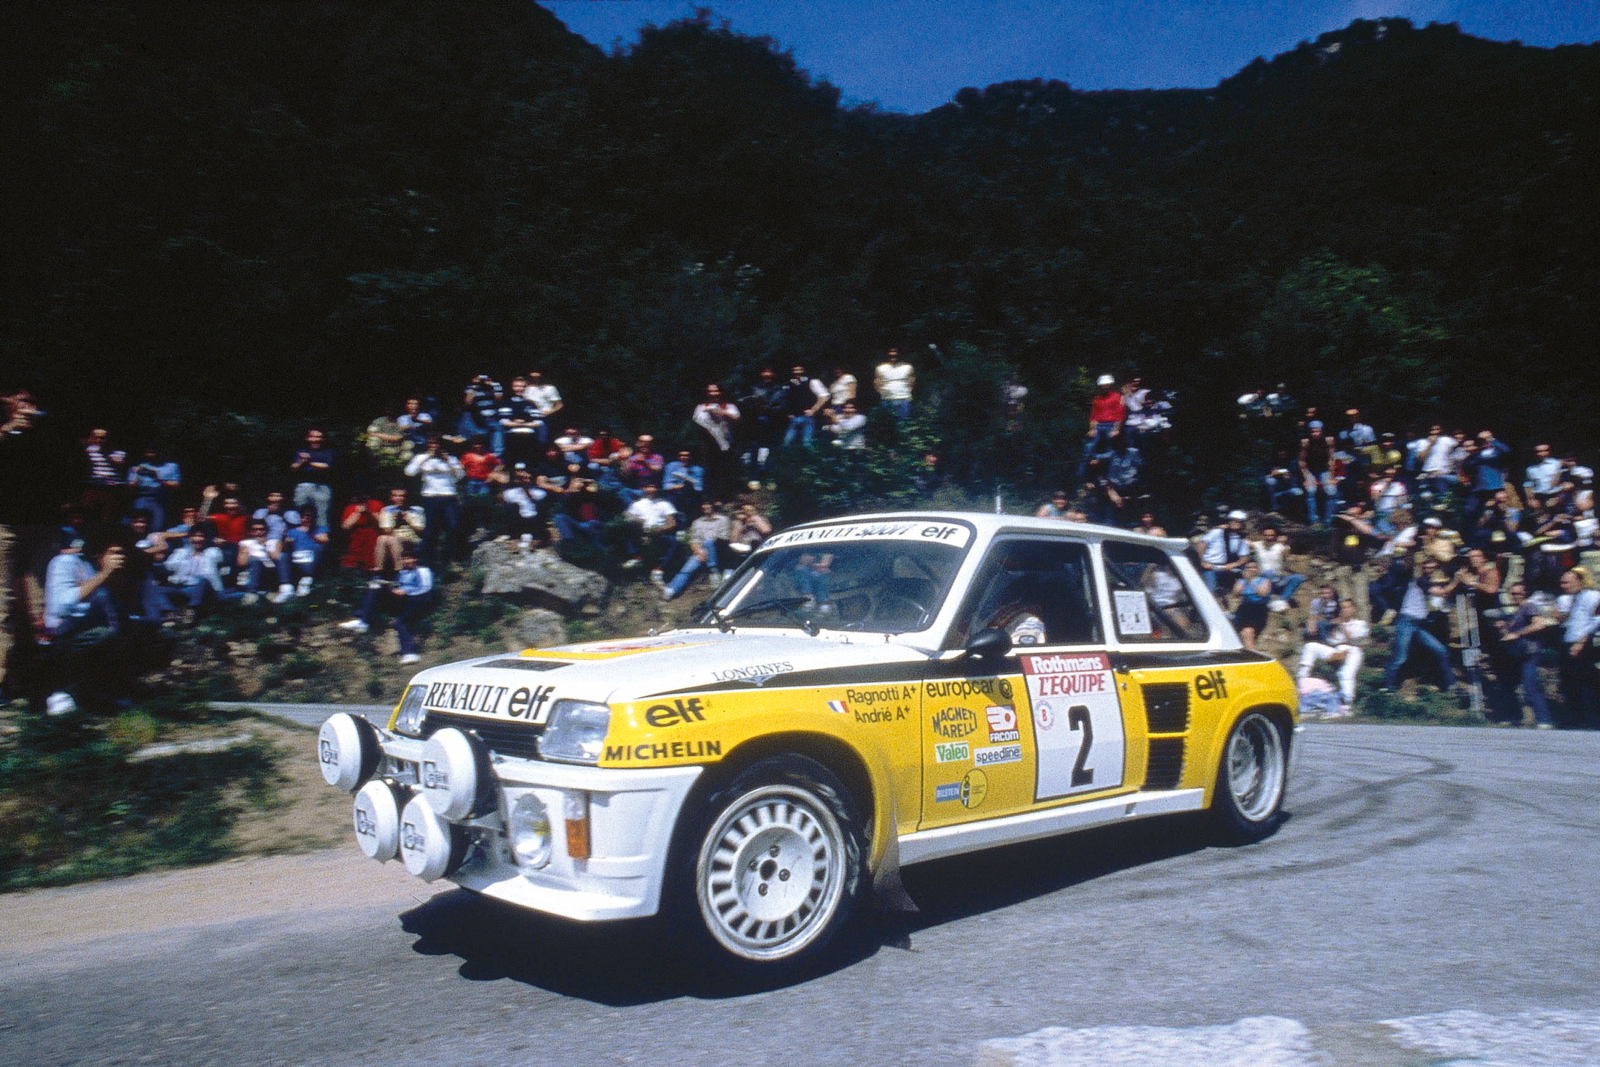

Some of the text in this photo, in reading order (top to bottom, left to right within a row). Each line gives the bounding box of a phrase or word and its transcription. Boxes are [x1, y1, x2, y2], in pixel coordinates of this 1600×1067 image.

[785, 528, 856, 544] RENAULT
[921, 526, 959, 540] elf
[712, 661, 794, 681] LONGINES
[1029, 656, 1104, 675] Rothmans
[926, 679, 994, 699] europcar
[1038, 673, 1105, 696] L'EQUIPE
[1195, 670, 1229, 701] elf
[424, 682, 556, 719] RENAULT elf
[846, 687, 899, 705] Ragnotti
[646, 699, 706, 728] elf
[854, 708, 893, 723] Andrié
[605, 741, 721, 761] MICHELIN
[936, 743, 968, 761] Valeo
[976, 747, 1021, 764] speedline
[1068, 705, 1094, 787] 2
